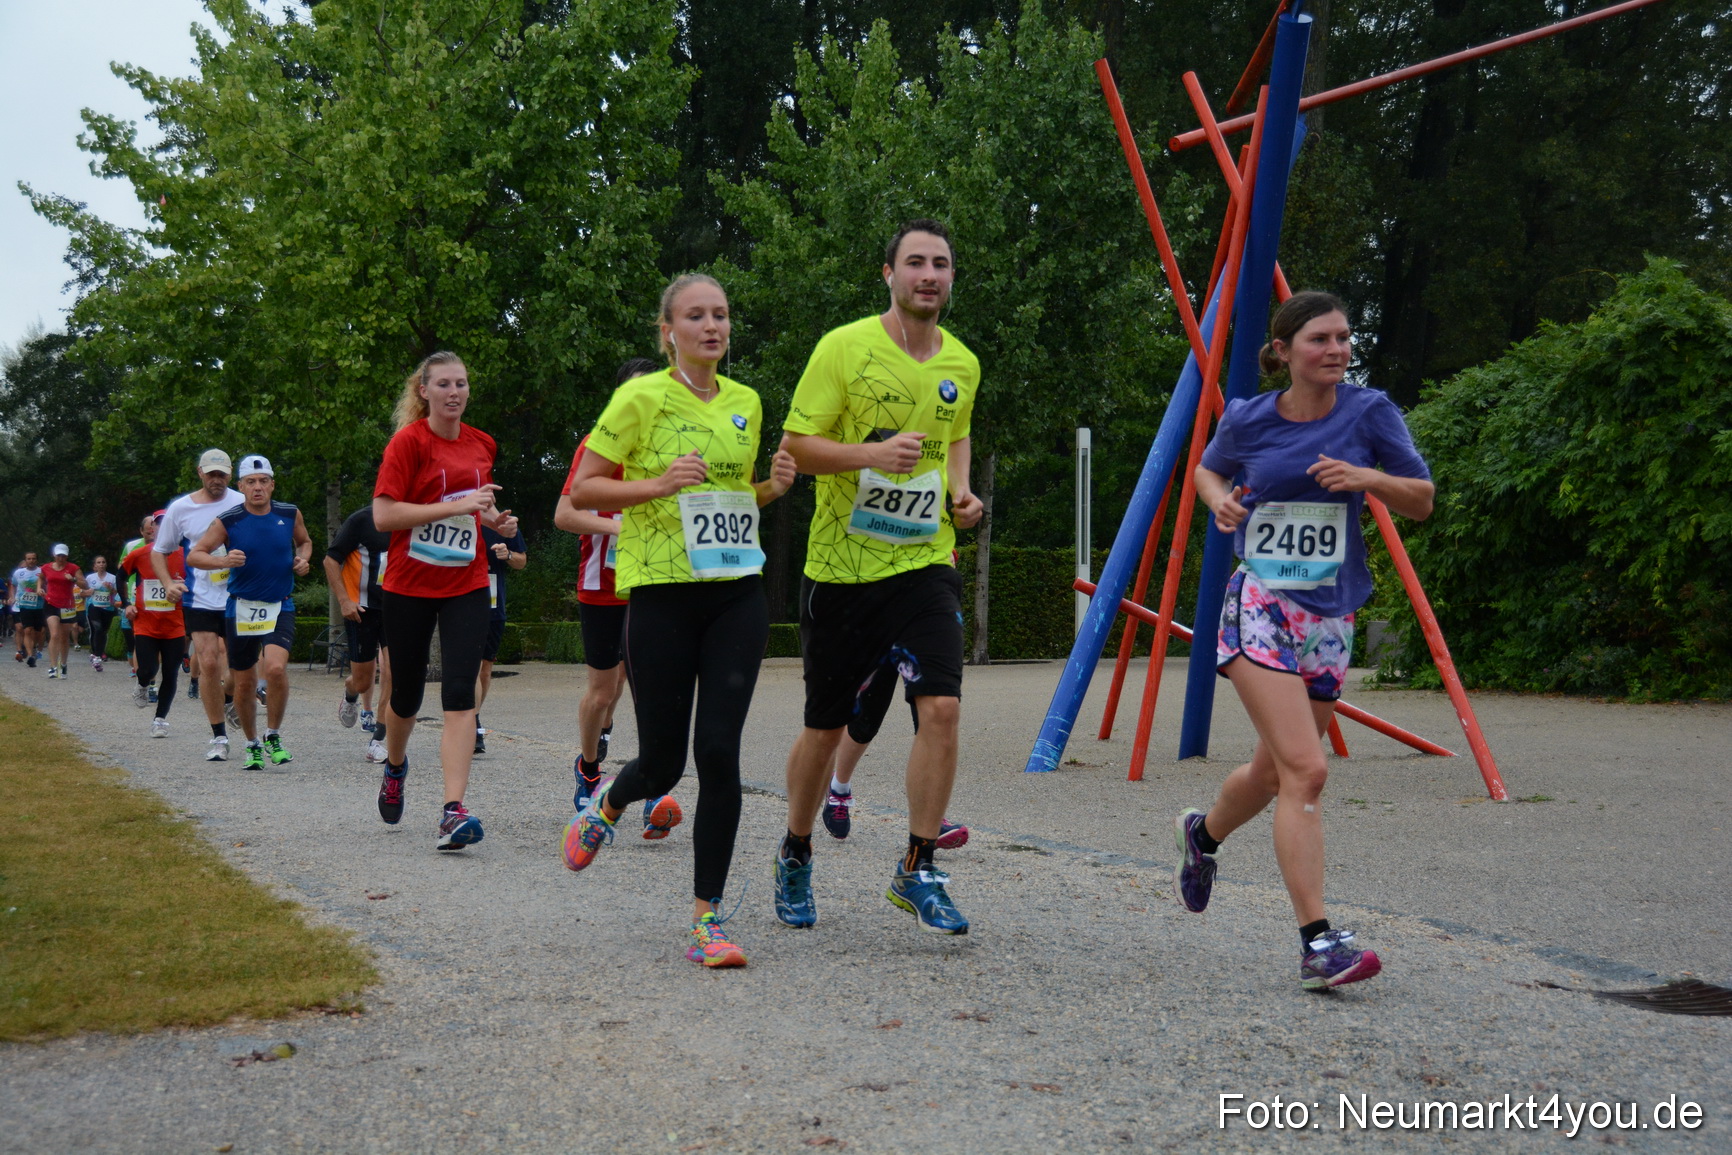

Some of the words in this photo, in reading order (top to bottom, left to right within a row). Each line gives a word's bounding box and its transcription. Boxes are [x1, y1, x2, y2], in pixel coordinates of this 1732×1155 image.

[921, 440, 943, 450] NEXT
[863, 487, 936, 519] 2872
[1291, 505, 1338, 517] BOCK
[693, 512, 753, 545] 2892
[866, 517, 922, 536] Johannes
[418, 522, 473, 551] 3078
[1255, 522, 1337, 558] 2469
[721, 552, 740, 565] Nina
[1277, 564, 1309, 578] Julia
[249, 607, 267, 621] 79
